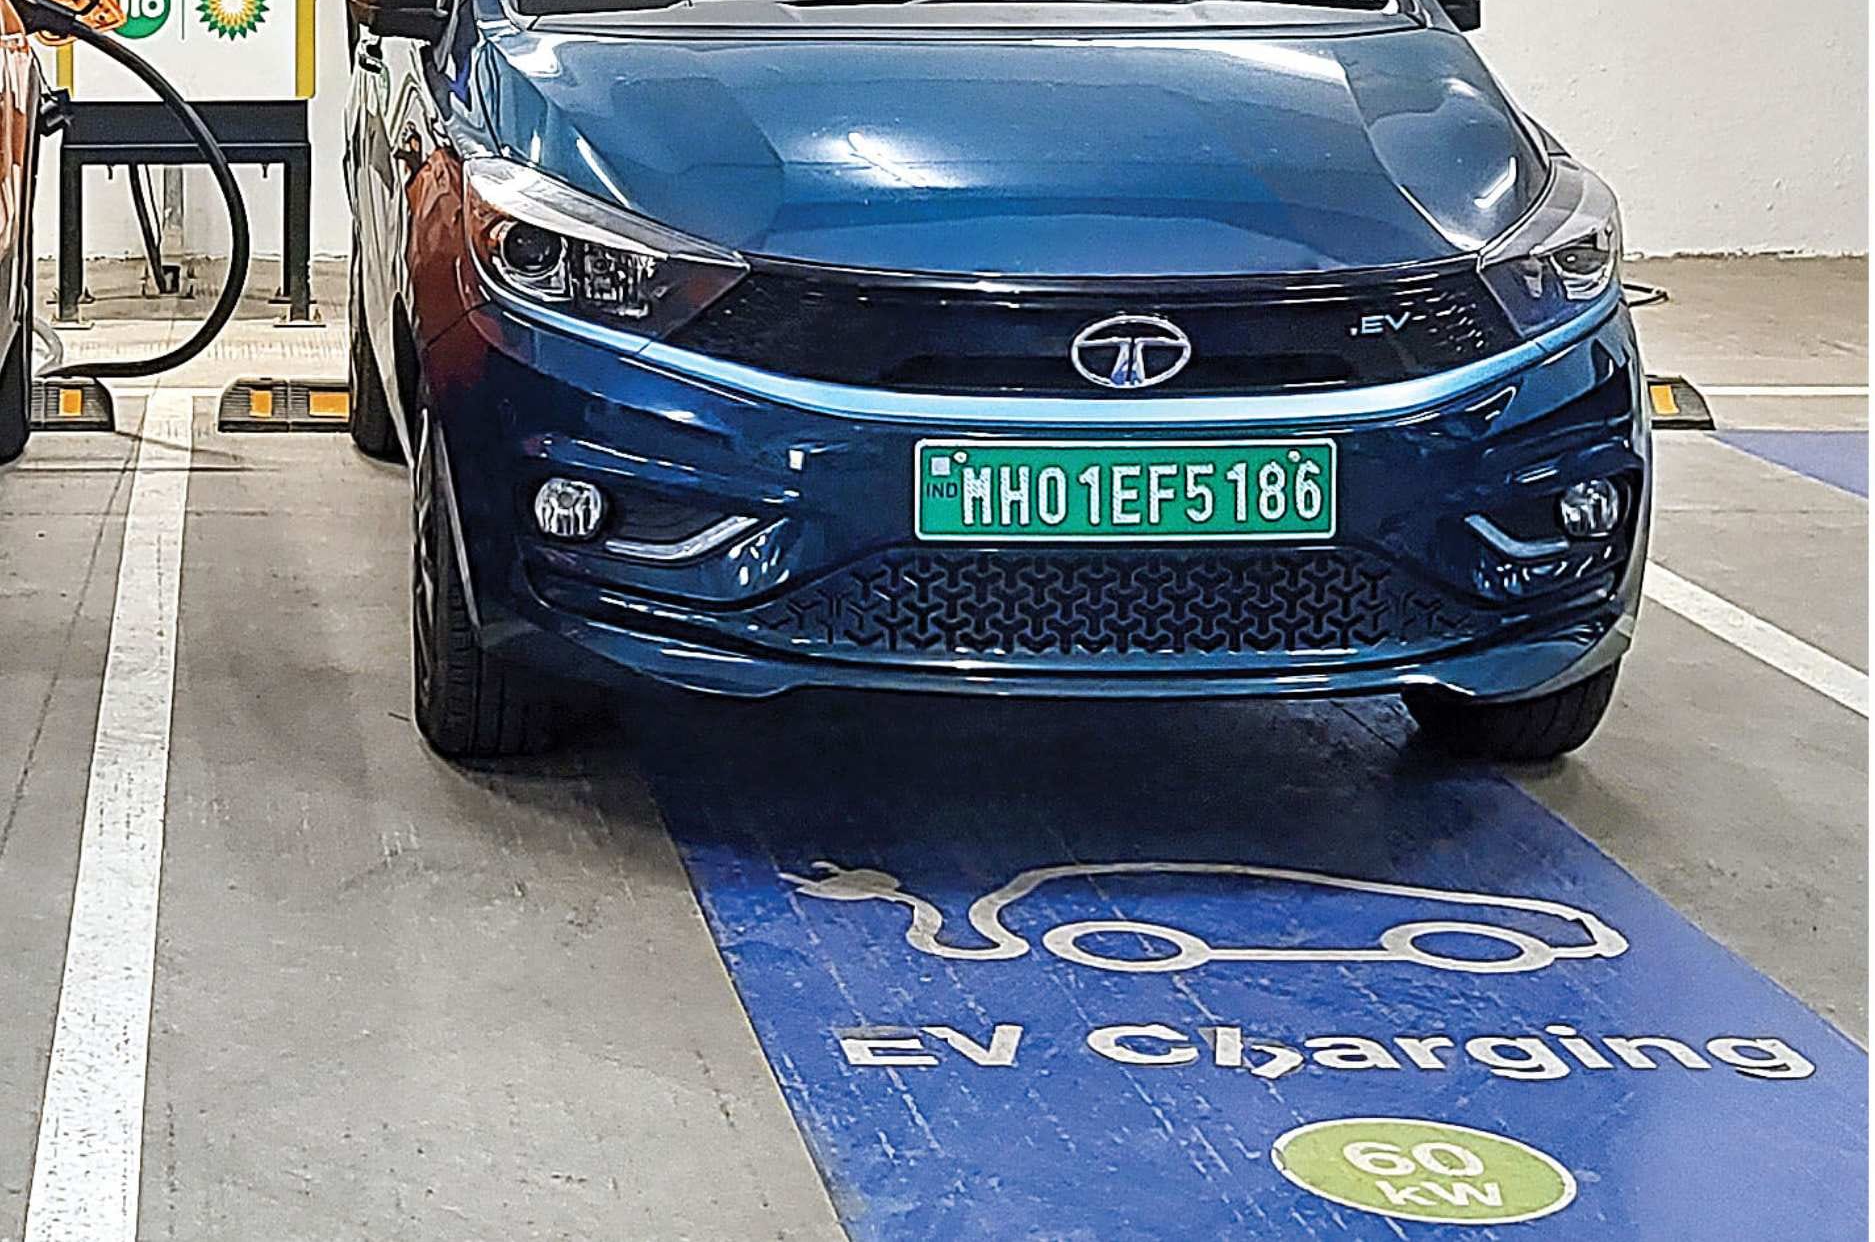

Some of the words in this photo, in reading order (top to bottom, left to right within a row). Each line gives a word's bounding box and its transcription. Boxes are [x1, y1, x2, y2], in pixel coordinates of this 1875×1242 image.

[926, 482, 958, 498] IND
[962, 460, 1322, 526] MH01EF5186
[832, 1024, 1023, 1067] EV
[1086, 1022, 1817, 1080] Charging
[1343, 1141, 1485, 1177] 60
